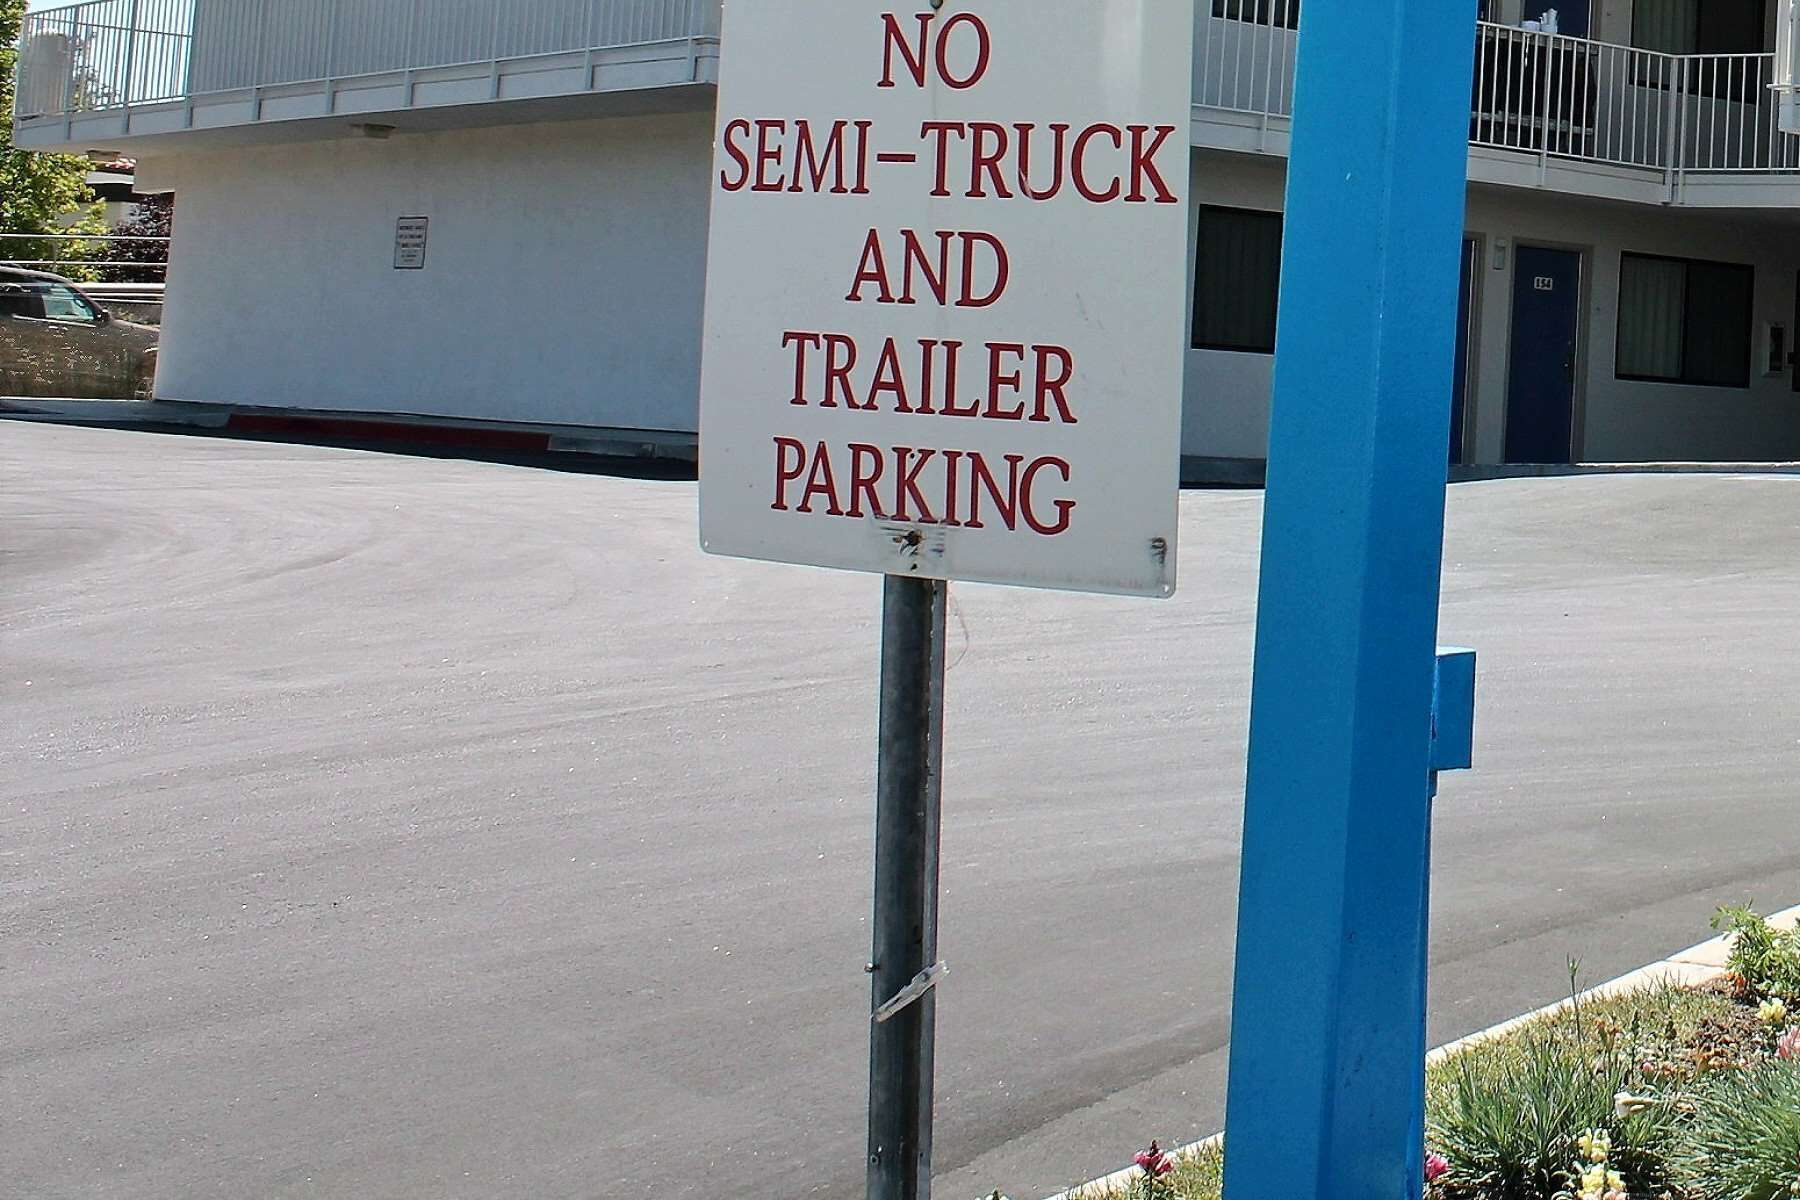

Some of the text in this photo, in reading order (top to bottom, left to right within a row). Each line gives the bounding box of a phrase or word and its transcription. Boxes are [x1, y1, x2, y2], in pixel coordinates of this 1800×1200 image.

[876, 12, 991, 90] NO
[720, 118, 1178, 204] SEMI-TRUCK
[845, 228, 1010, 308] AND
[782, 331, 1078, 424] TRAILER
[771, 436, 1077, 536] PARKING
